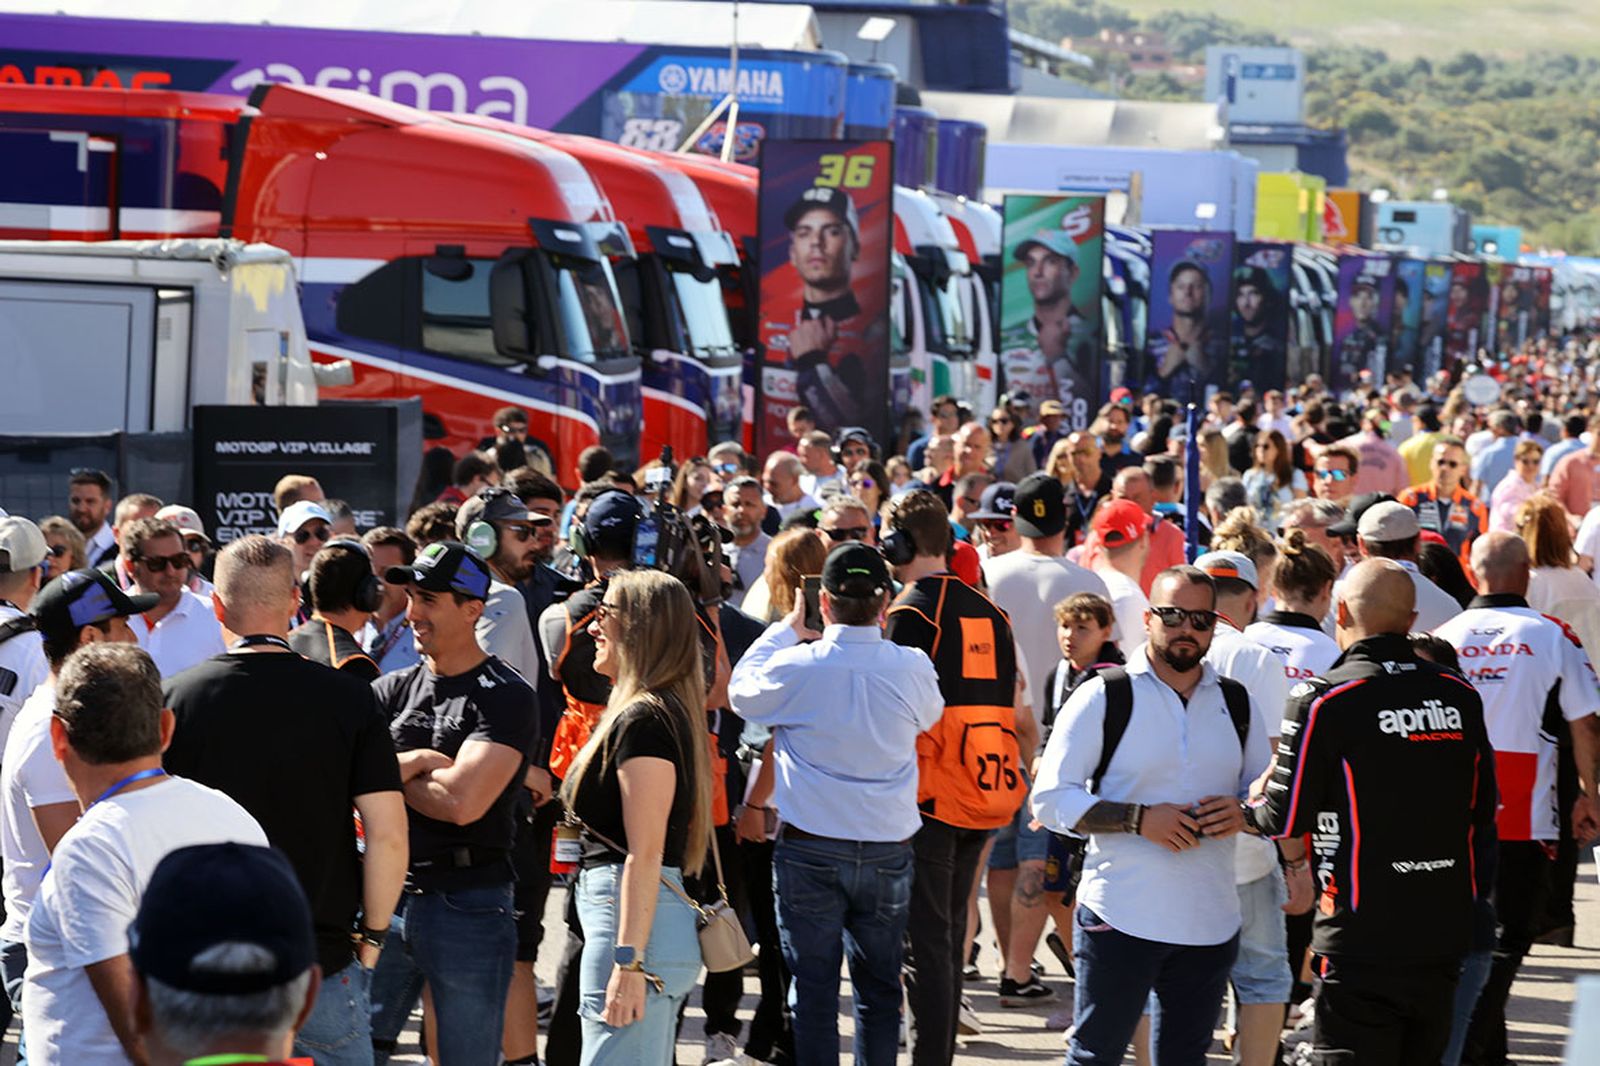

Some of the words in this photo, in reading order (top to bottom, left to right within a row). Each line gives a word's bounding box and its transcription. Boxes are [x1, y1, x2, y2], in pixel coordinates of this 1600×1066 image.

[687, 66, 784, 97] YAMAHA
[814, 154, 876, 188] 36
[215, 441, 277, 454] MOTOGP
[280, 442, 309, 454] VIP
[216, 510, 265, 526] VIP
[1377, 698, 1463, 738] aprilia
[1408, 732, 1464, 742] RACING
[976, 753, 1018, 791] 276
